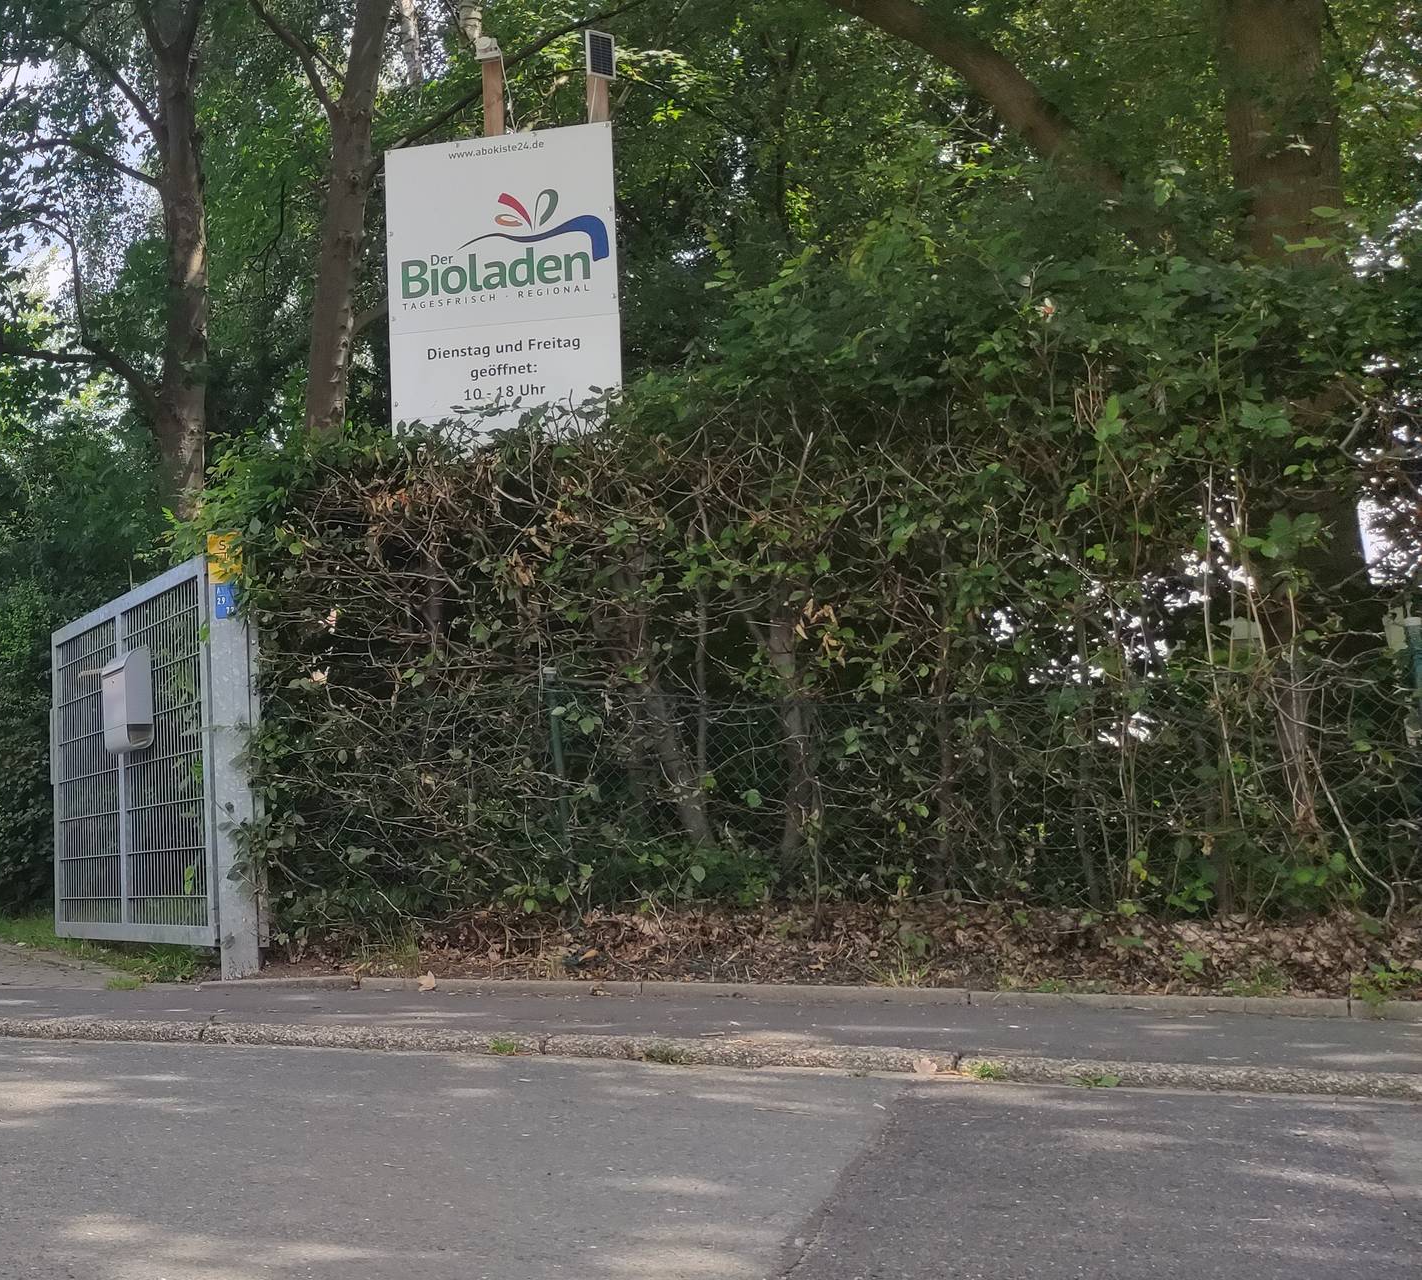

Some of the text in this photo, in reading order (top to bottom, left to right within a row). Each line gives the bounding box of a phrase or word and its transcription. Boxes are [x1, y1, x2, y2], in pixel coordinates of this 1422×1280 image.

[448, 139, 545, 160] www.abokiste24.de
[430, 253, 454, 266] Der
[401, 246, 591, 300] Bioladen
[402, 293, 497, 311] TAGESFRISCH
[517, 284, 591, 299] REGIONAL
[427, 336, 581, 360] Dienstag und Freitag
[470, 361, 538, 381] geöffnet:
[464, 387, 482, 401] 10
[496, 385, 514, 398] 18
[519, 383, 546, 396] Uhr
